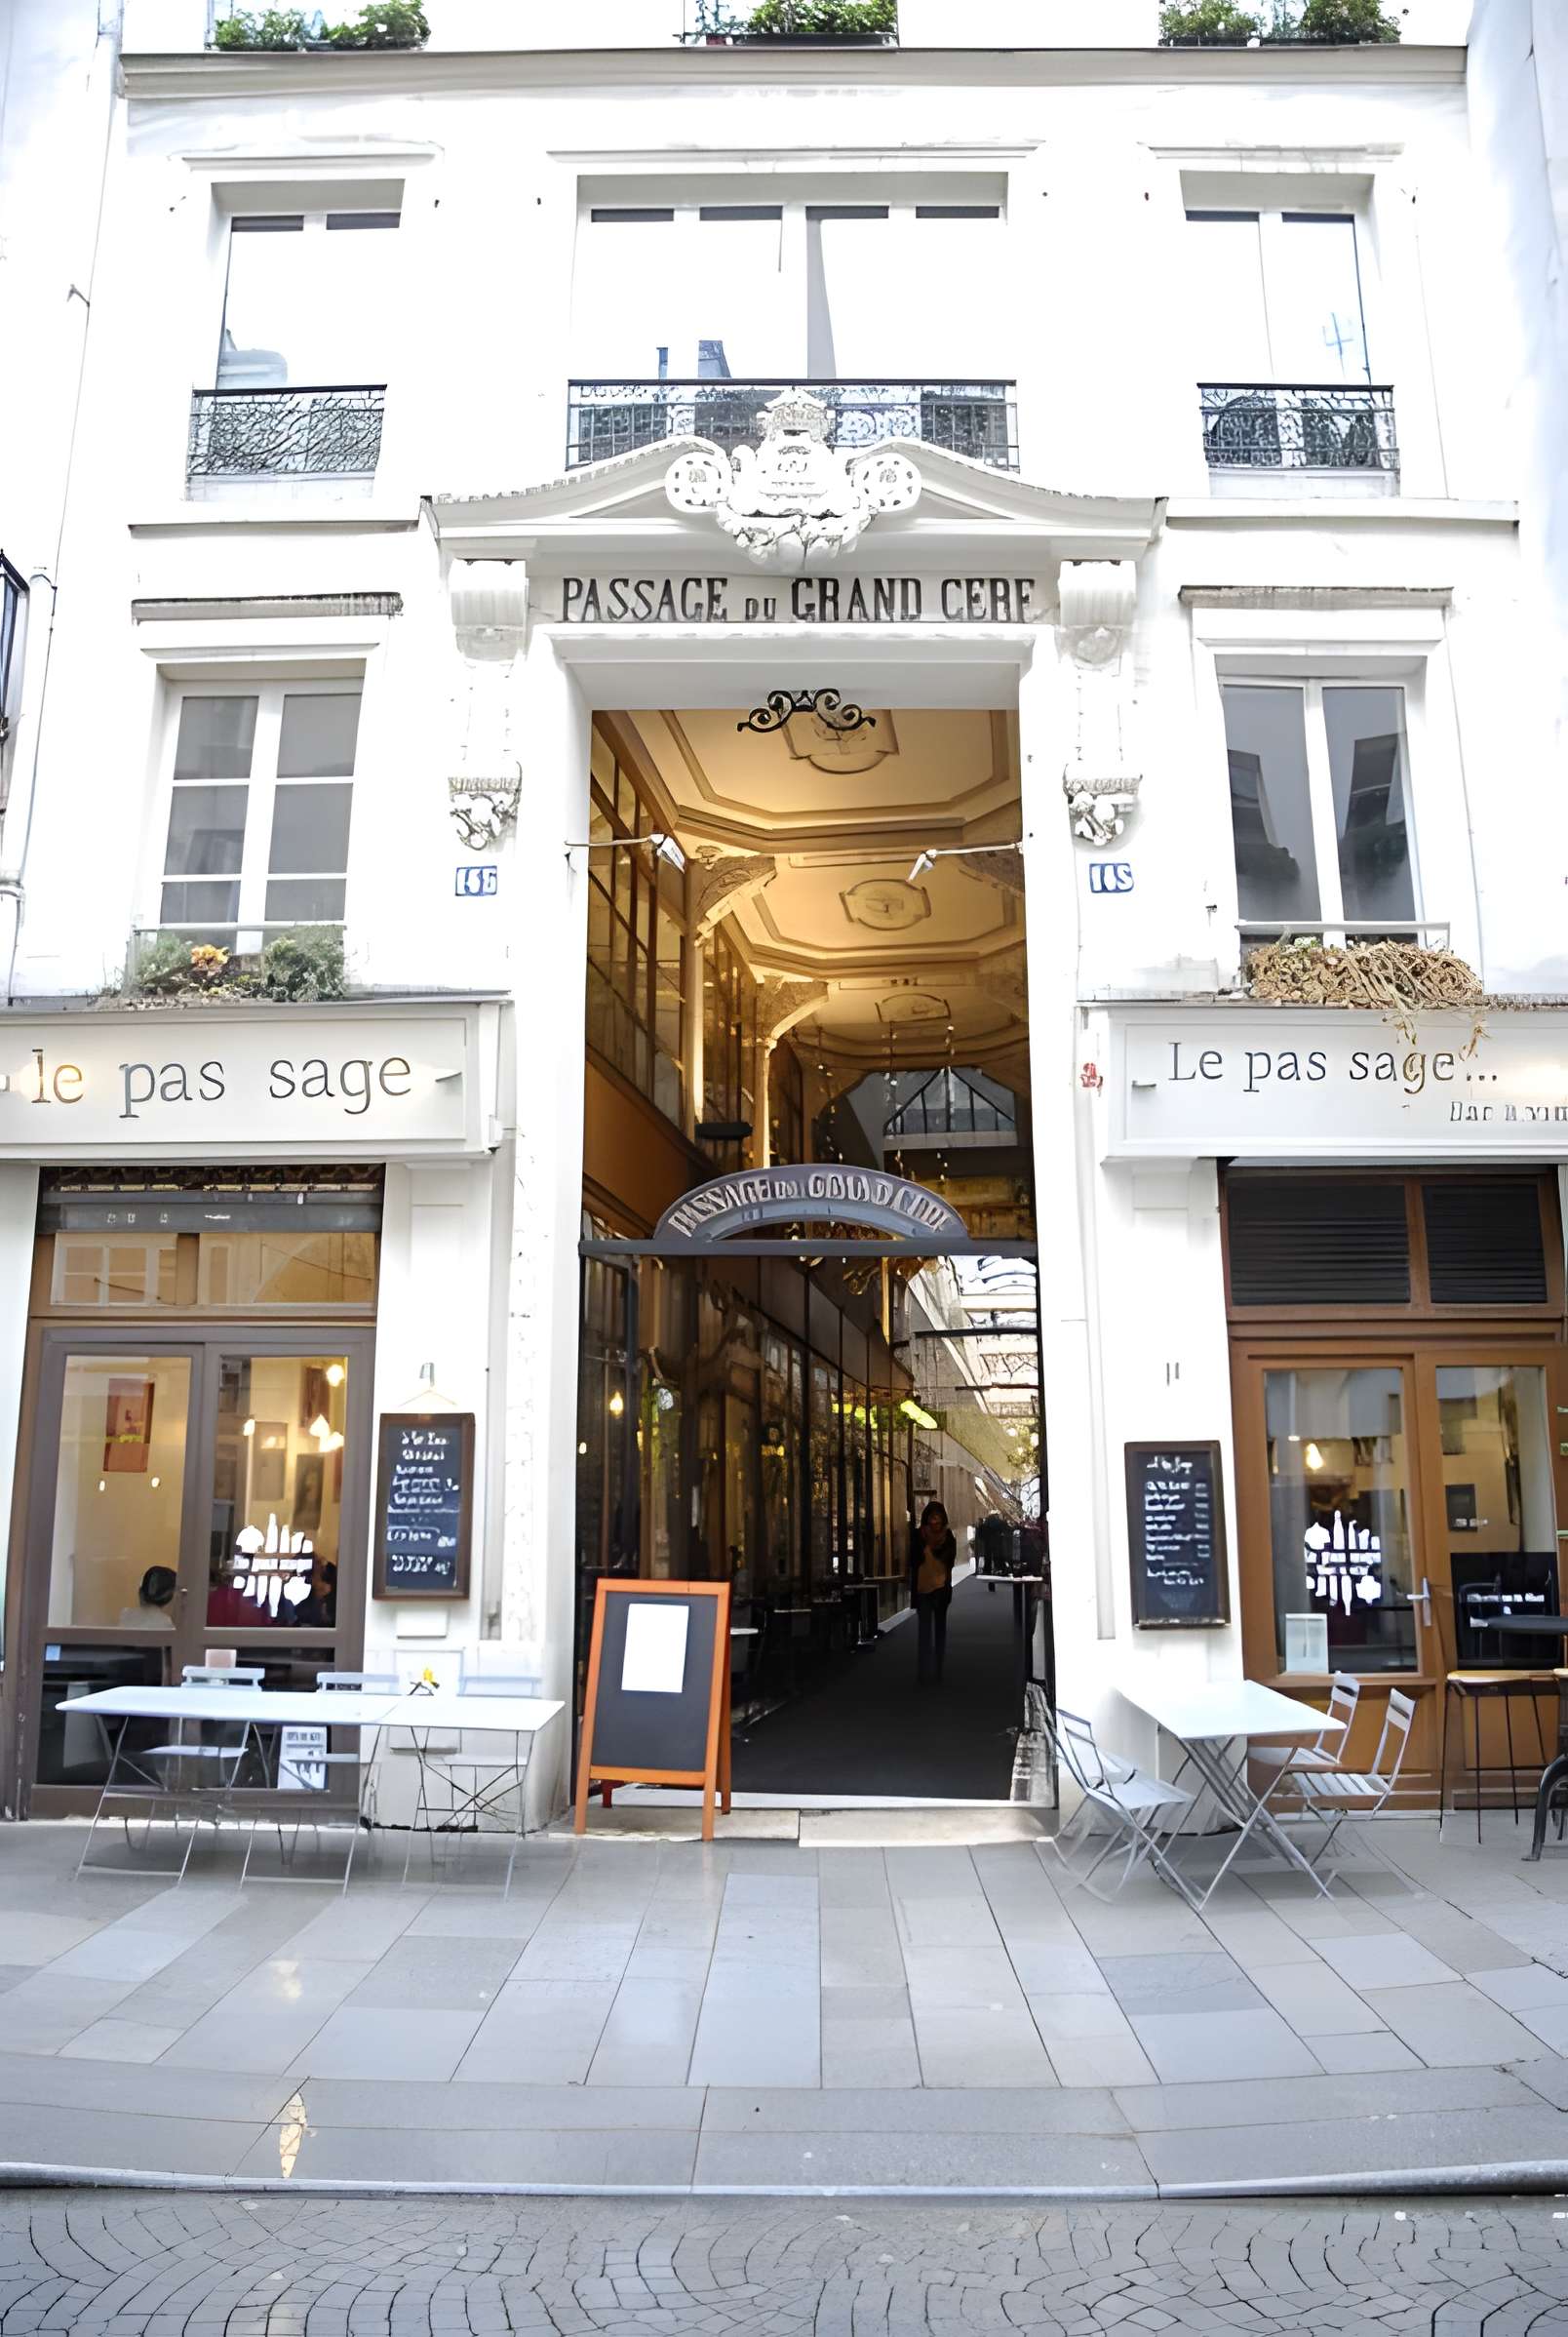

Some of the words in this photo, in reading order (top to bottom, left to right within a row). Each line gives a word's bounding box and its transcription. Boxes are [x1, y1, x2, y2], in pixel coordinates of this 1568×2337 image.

[563, 577, 727, 621] PASSAGE
[791, 577, 921, 621] GRAND
[941, 577, 1035, 622] CERF
[32, 1049, 84, 1103] le
[119, 1060, 225, 1118] pas
[269, 1056, 412, 1114] sage
[1168, 1042, 1223, 1081] Le
[1243, 1050, 1327, 1092] pas
